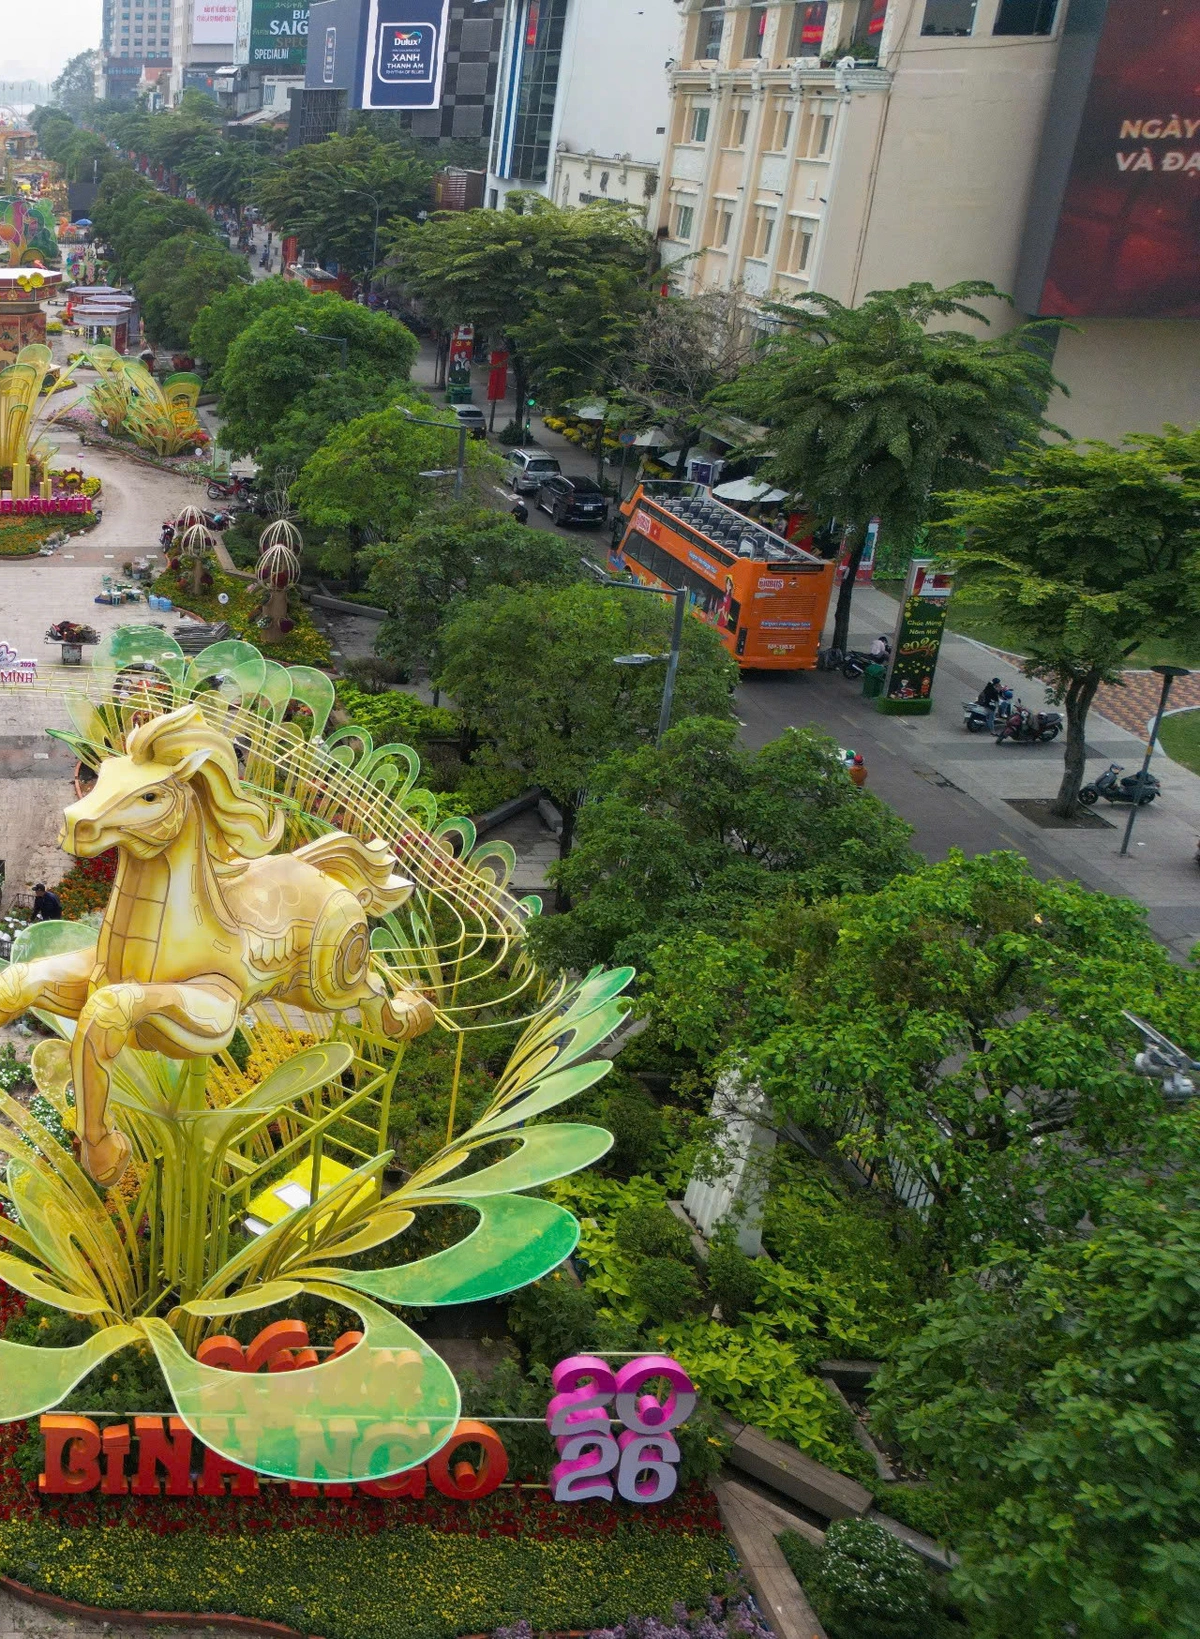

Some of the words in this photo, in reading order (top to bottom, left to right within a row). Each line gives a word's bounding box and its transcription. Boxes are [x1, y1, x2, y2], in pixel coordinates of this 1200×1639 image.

[269, 20, 309, 36] SAIG
[394, 37, 418, 46] Dulux
[391, 53, 421, 62] XANH
[1119, 113, 1200, 139] NGÀY
[1116, 147, 1154, 172] VÀ
[903, 637, 940, 652] 2026
